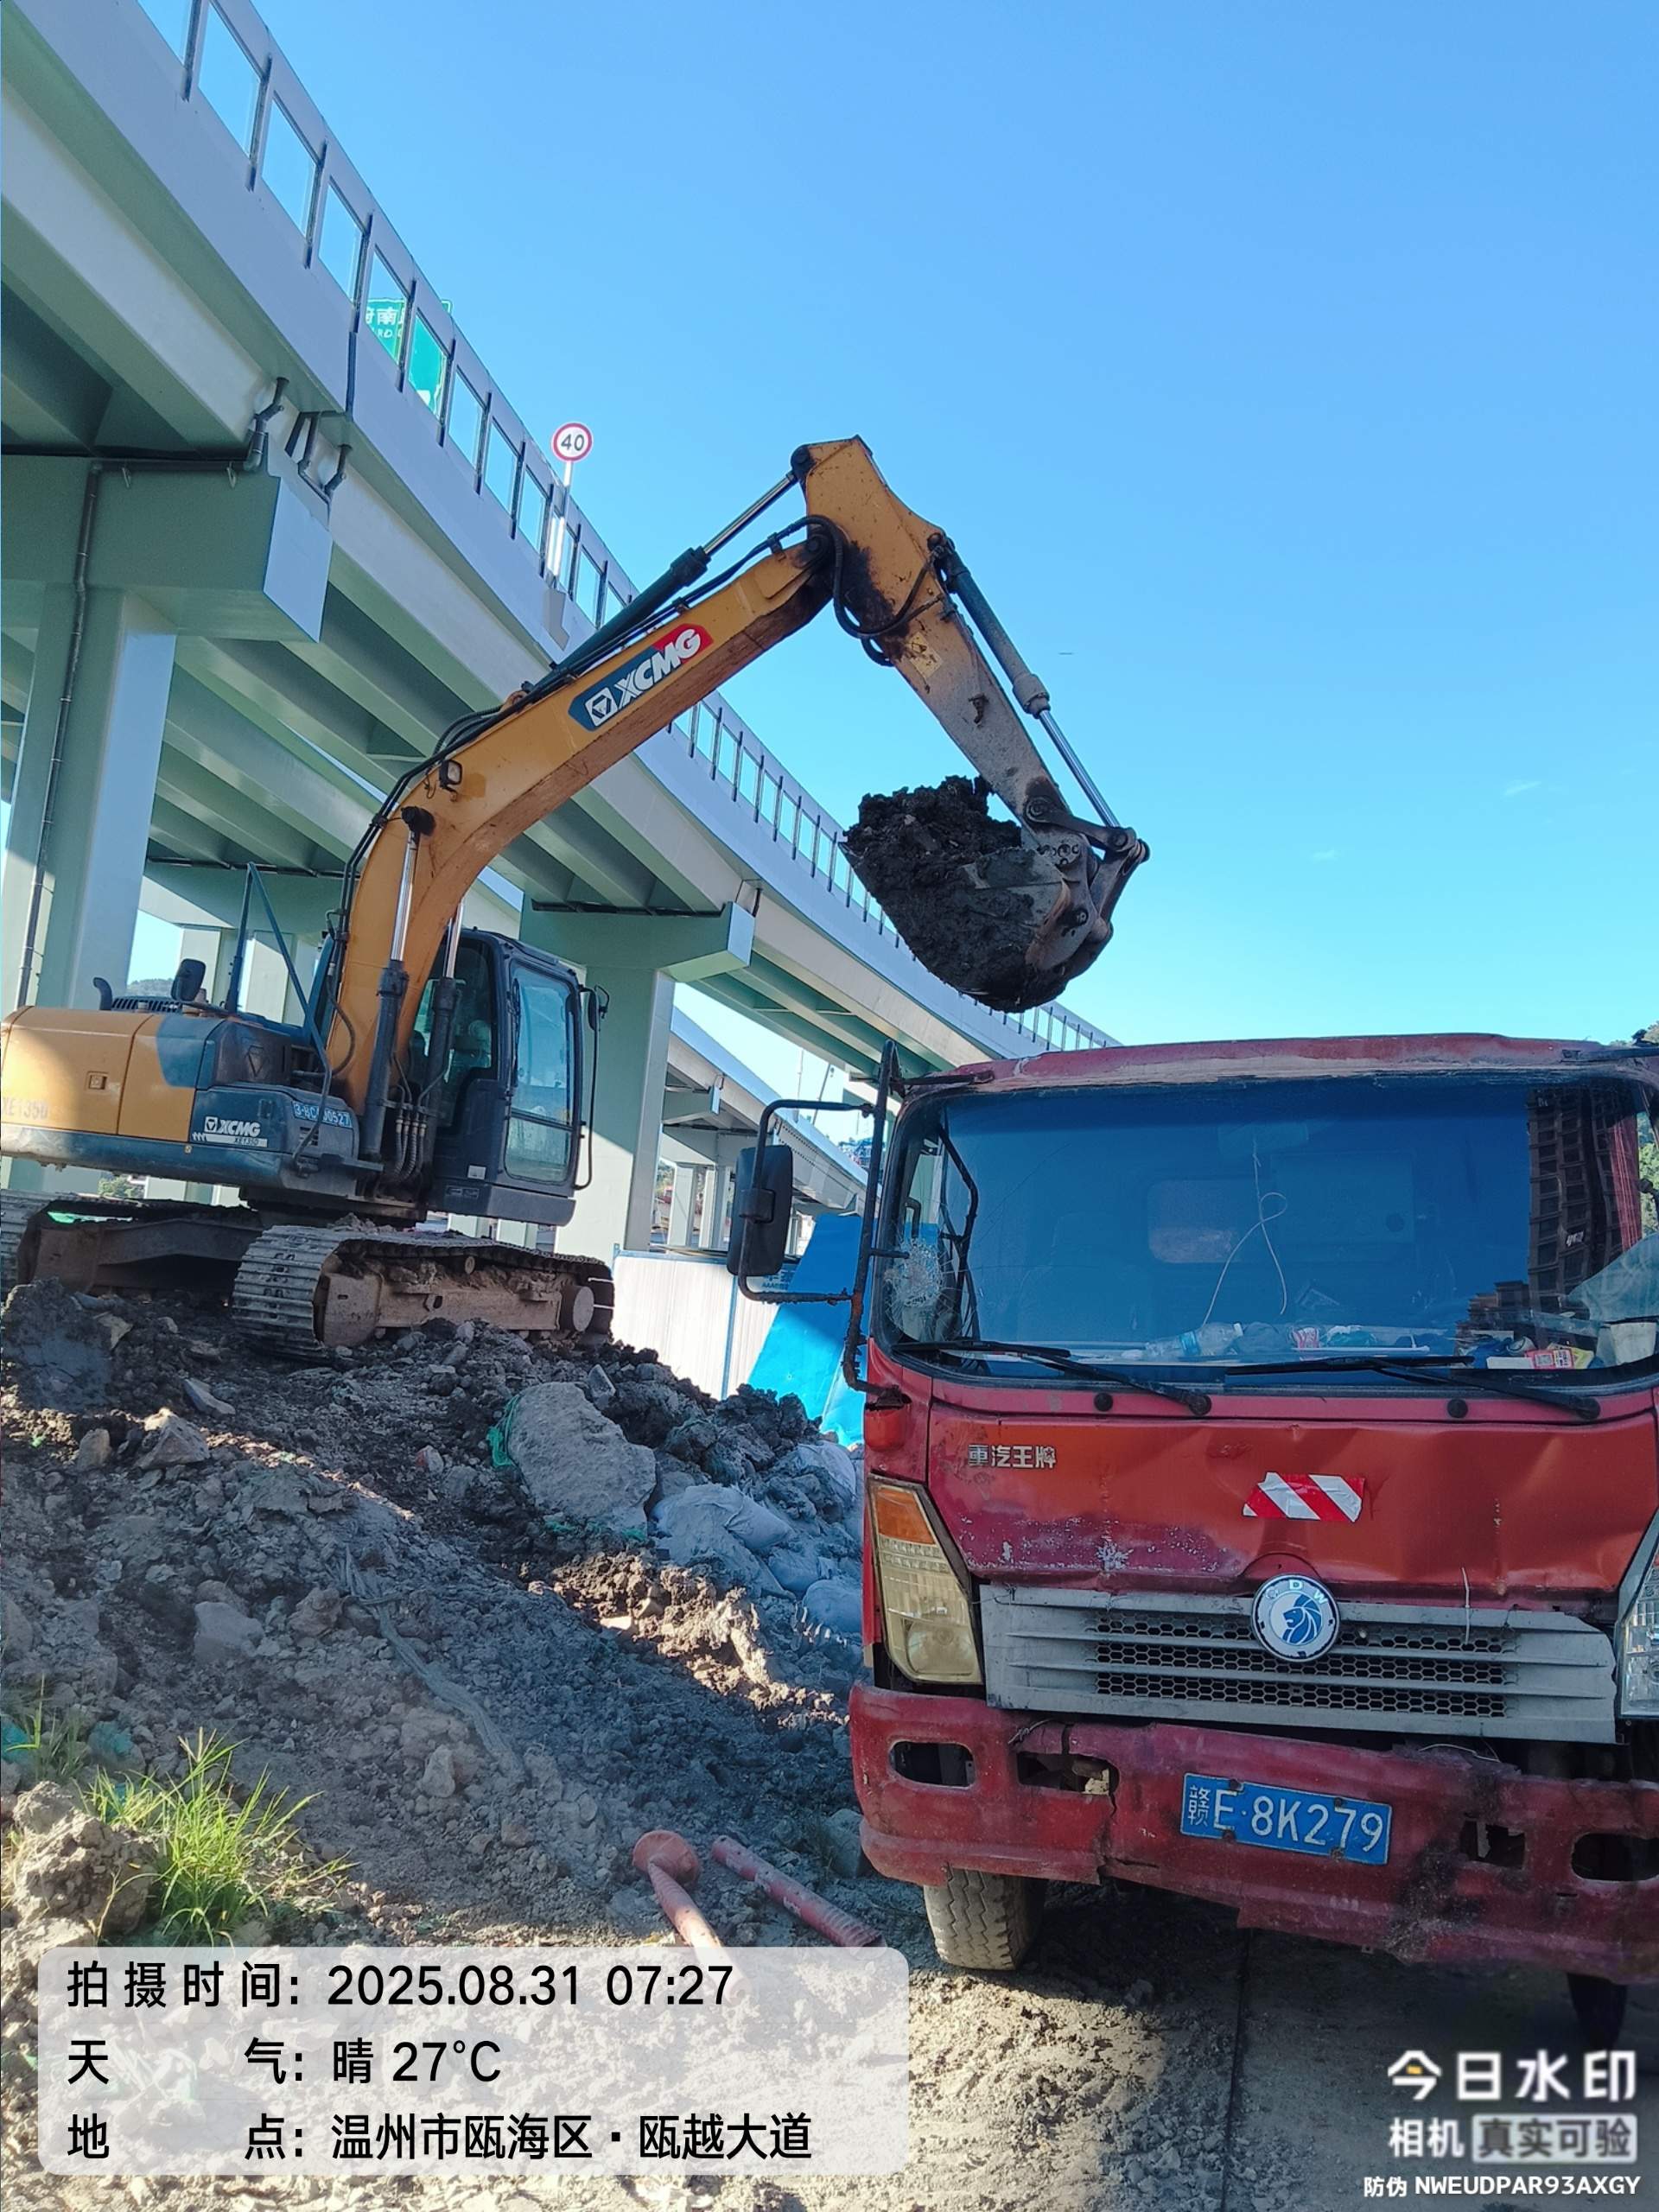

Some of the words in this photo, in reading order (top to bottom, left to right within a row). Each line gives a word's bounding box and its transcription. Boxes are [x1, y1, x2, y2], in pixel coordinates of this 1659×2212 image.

[561, 433, 585, 451] 40
[614, 628, 702, 710] XCMG
[217, 1119, 261, 1137] XCMG
[968, 1444, 1057, 1469] 重汽王牌
